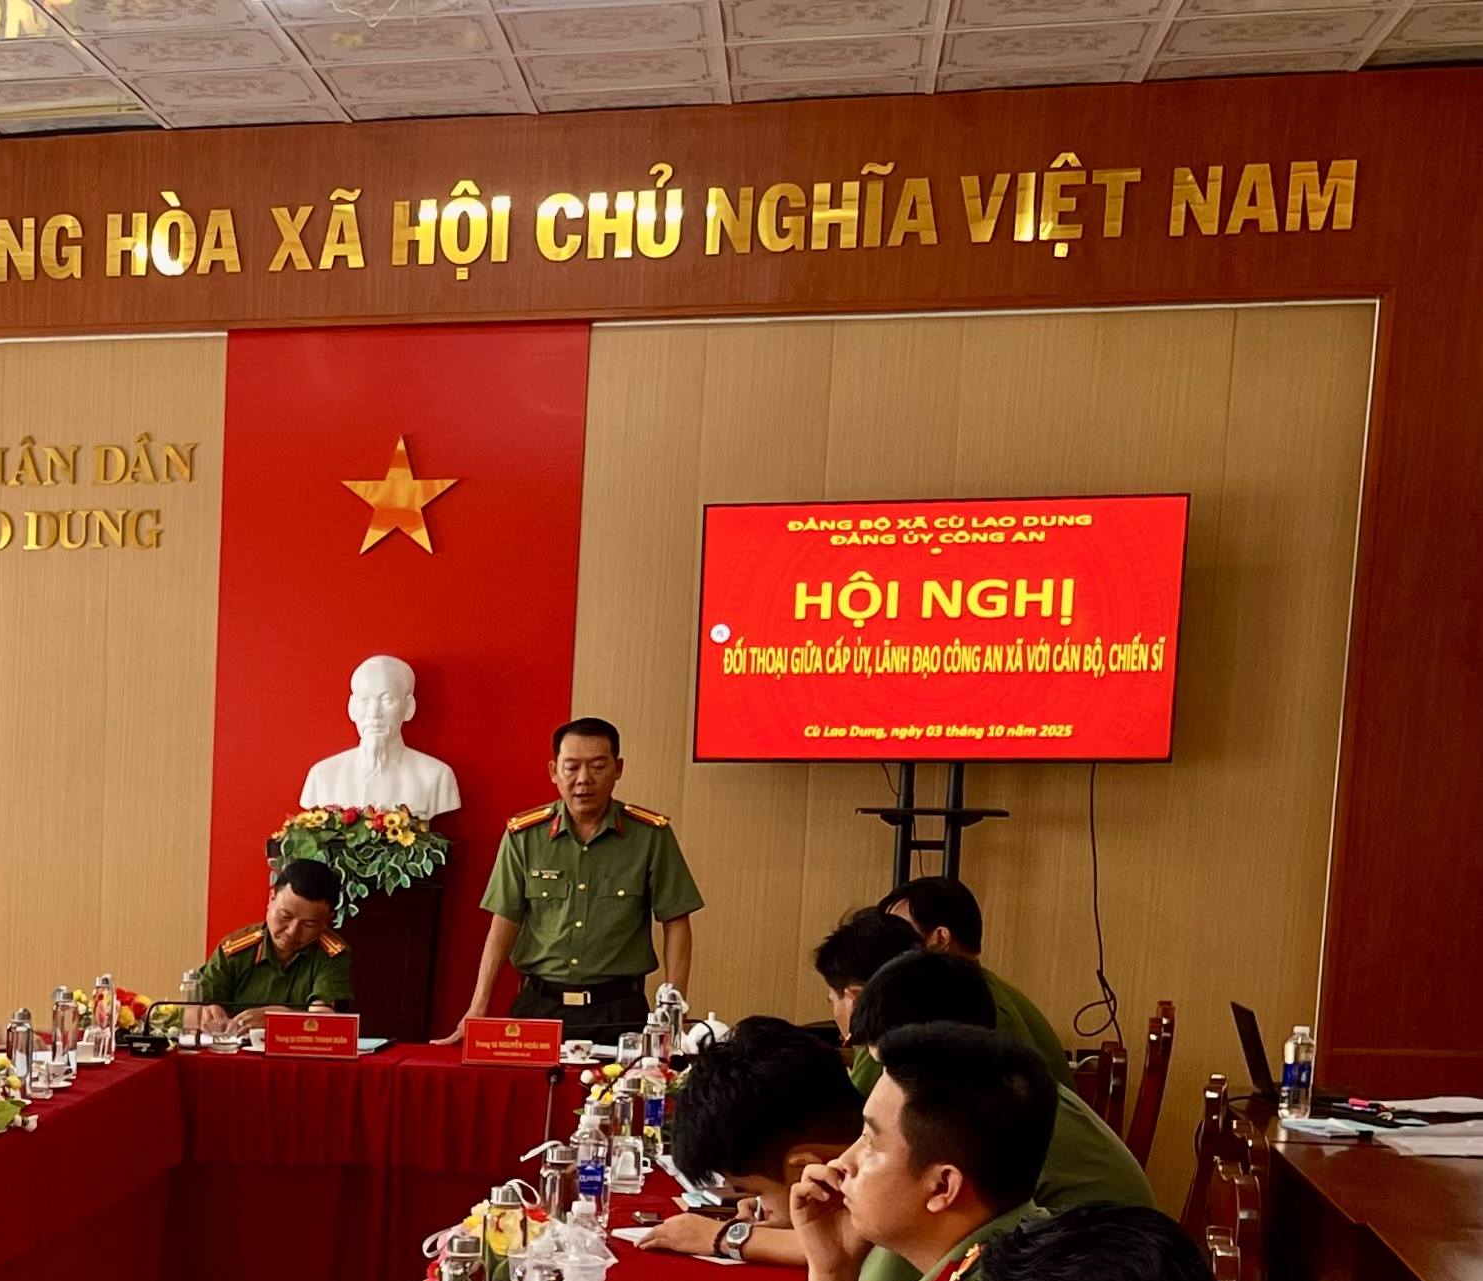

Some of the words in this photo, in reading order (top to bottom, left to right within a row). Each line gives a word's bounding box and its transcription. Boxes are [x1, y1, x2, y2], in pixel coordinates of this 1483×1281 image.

[106, 190, 242, 277] HÒA
[268, 187, 366, 272] XÃ
[391, 179, 512, 281] HỘI
[535, 162, 683, 262] CHỦ
[705, 161, 938, 256] NGHĨA
[960, 151, 1142, 258] VIỆT
[1168, 159, 1358, 237] NAM
[92, 431, 200, 485] DÂN
[22, 508, 166, 551] DUNG
[787, 516, 853, 532] ĐẢNG
[859, 516, 892, 532] BỘ
[897, 515, 928, 530] XÃ
[933, 515, 965, 529] CÙ
[971, 516, 1017, 528] LAO
[1022, 514, 1093, 527] DUNG
[830, 531, 896, 546] ĐẢNG
[902, 530, 934, 545] ỦY
[939, 530, 1005, 543] CÔNG
[1011, 531, 1046, 543] AN
[794, 570, 899, 629] HỘI
[921, 577, 1076, 626] NGHỊ
[723, 636, 747, 674] ĐỐI
[749, 645, 789, 680] THOẠI
[790, 639, 823, 674] GIỮA
[825, 635, 851, 674] CẤP
[853, 635, 873, 679] ỦY,
[875, 639, 910, 674] LÃNH
[912, 644, 941, 680] ĐẠO
[943, 638, 981, 673] CÔNG
[983, 644, 1004, 673] AN
[1005, 637, 1024, 673] XÃ
[1026, 636, 1050, 673] VỚI
[1052, 636, 1081, 673] CÁN
[1083, 636, 1105, 678] BỘ,
[1108, 632, 1149, 673] CHIẾN
[1151, 635, 1166, 672] SĨ
[804, 725, 821, 738] Cù
[824, 725, 847, 738] Lao
[849, 725, 888, 740] Dung,
[891, 725, 924, 740] ngày
[926, 725, 942, 738] 03
[945, 725, 984, 740] tháng
[987, 725, 1004, 738] 10
[1006, 725, 1037, 738] năm
[1039, 724, 1073, 738] 2025
